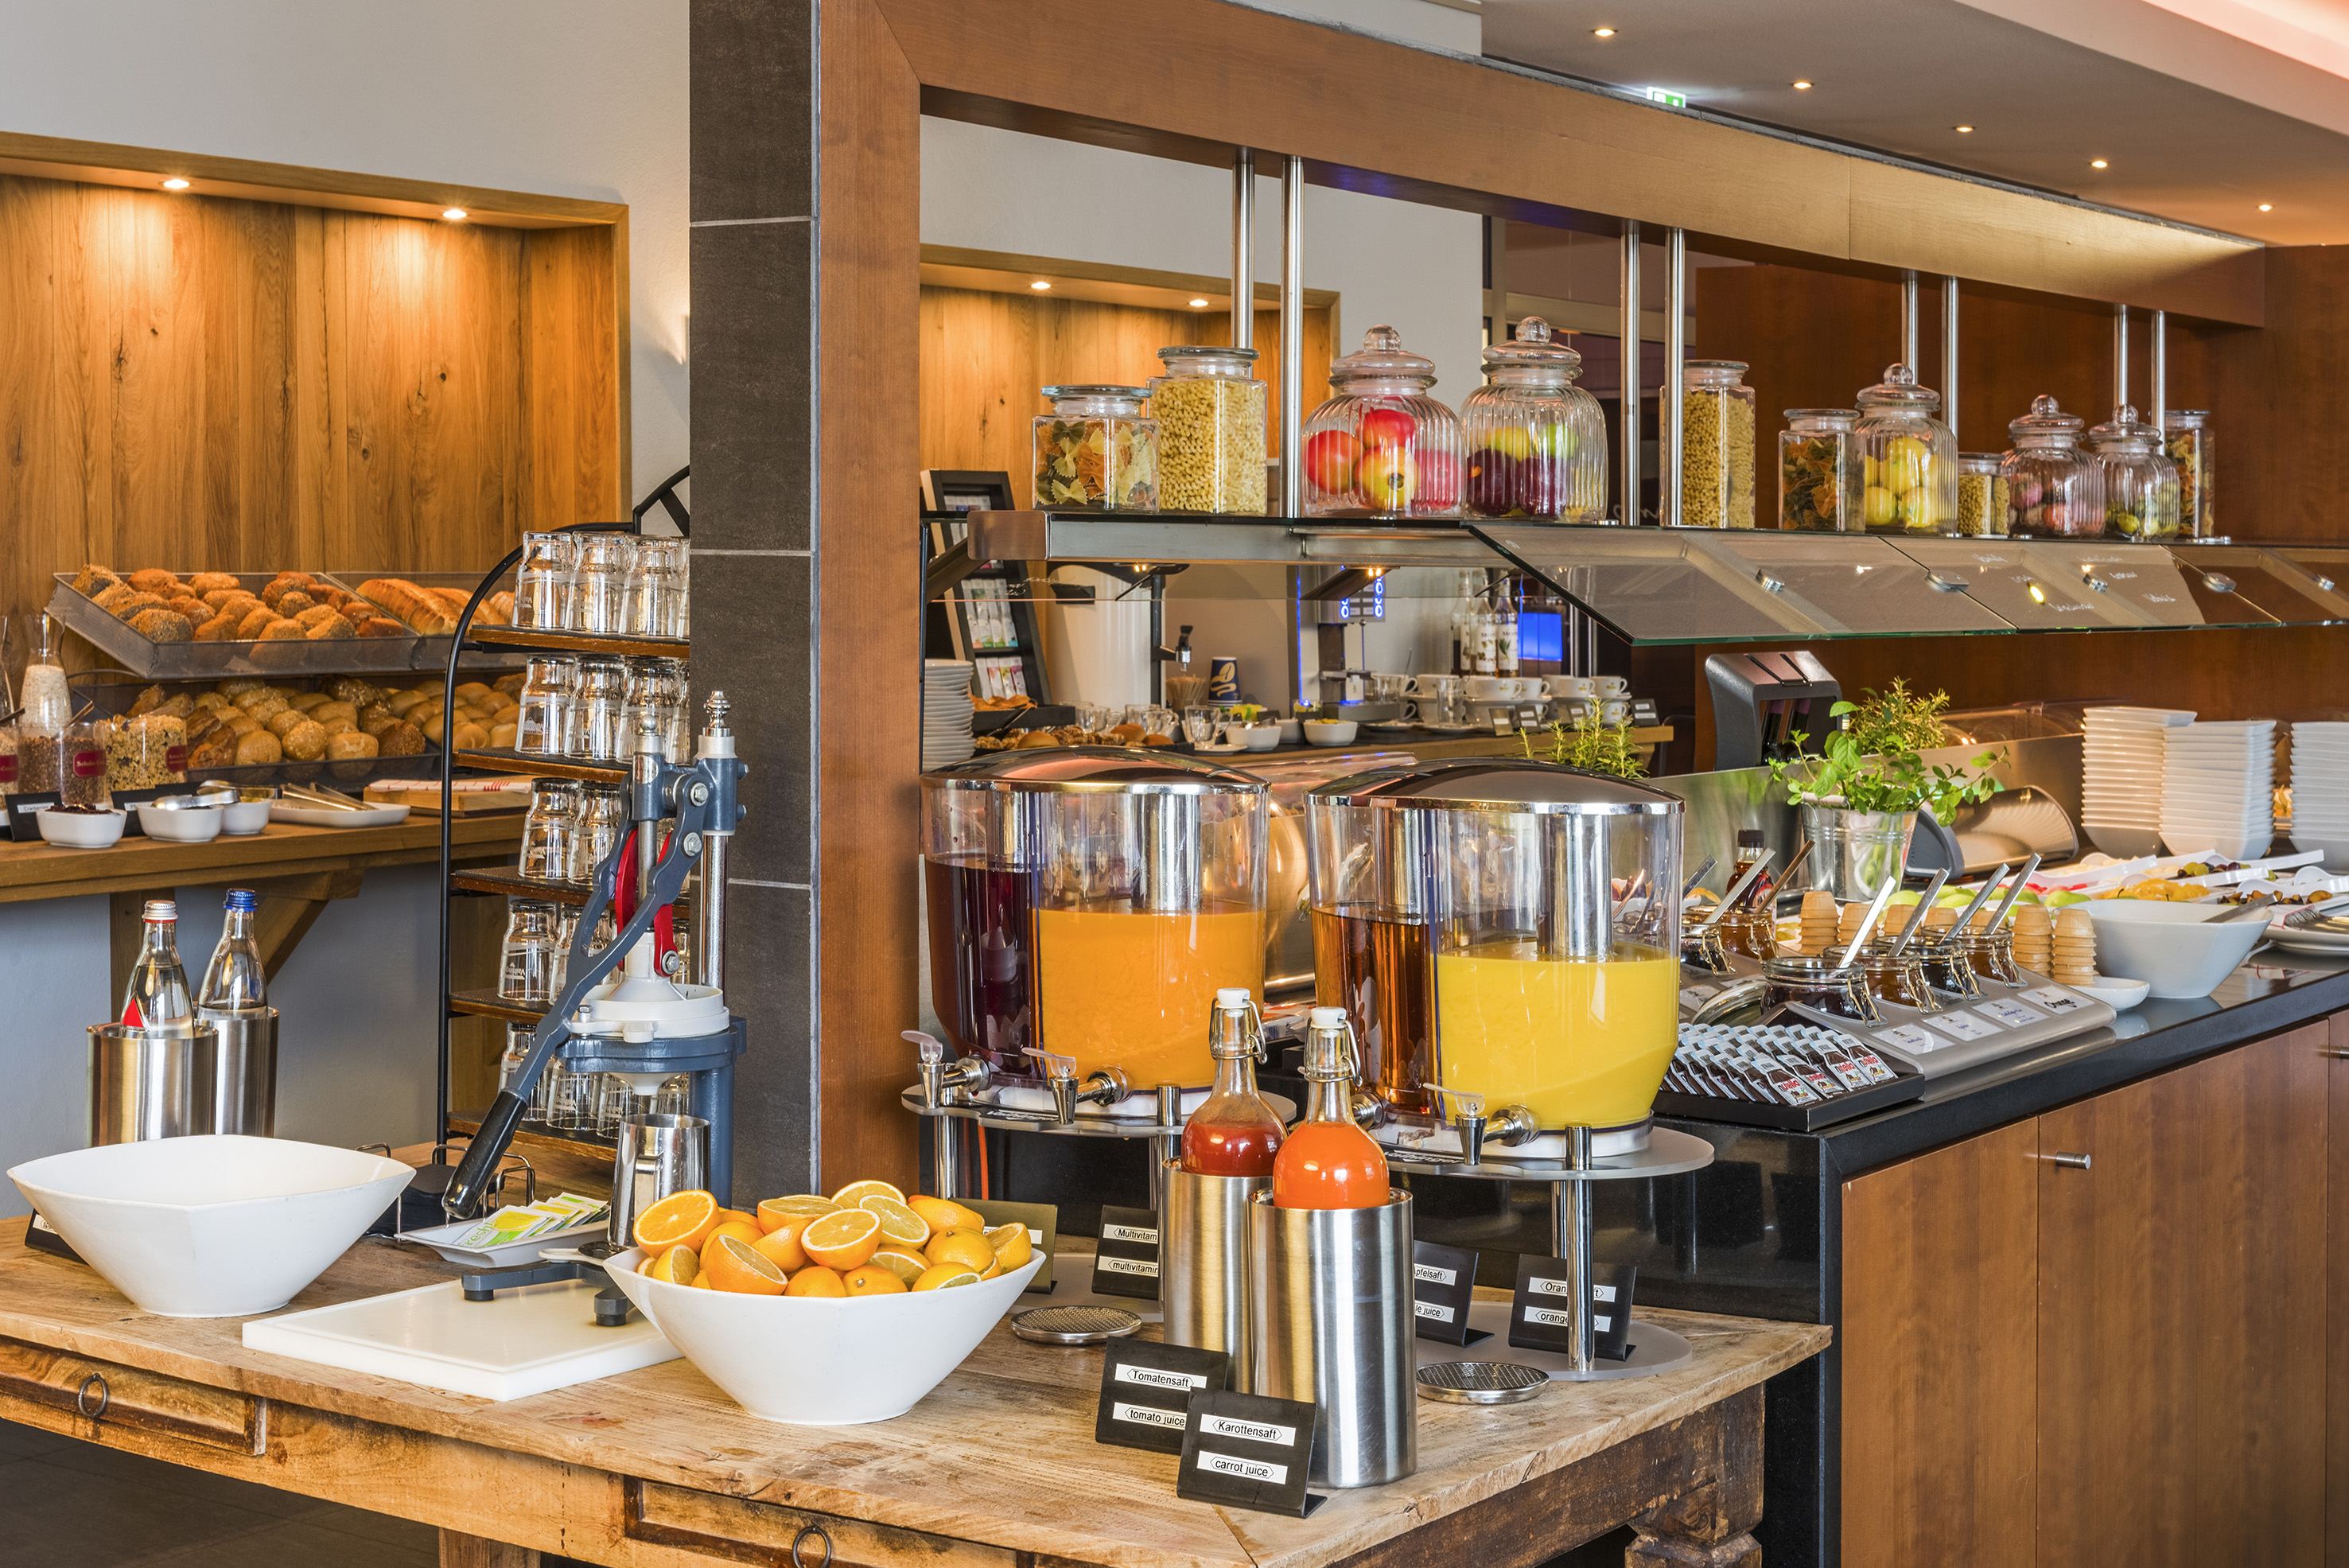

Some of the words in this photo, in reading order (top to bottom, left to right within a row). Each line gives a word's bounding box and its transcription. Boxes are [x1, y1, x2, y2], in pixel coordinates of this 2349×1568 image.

[1414, 1268, 1443, 1280] pfelsaft
[1423, 1305, 1441, 1317] juice
[1133, 1370, 1188, 1387] Tomatensaft
[1130, 1409, 1161, 1422] tomato
[1163, 1414, 1185, 1426] juice
[1218, 1421, 1277, 1439] Karottensaft
[1215, 1460, 1243, 1472] carrot
[1245, 1464, 1269, 1477] juice
